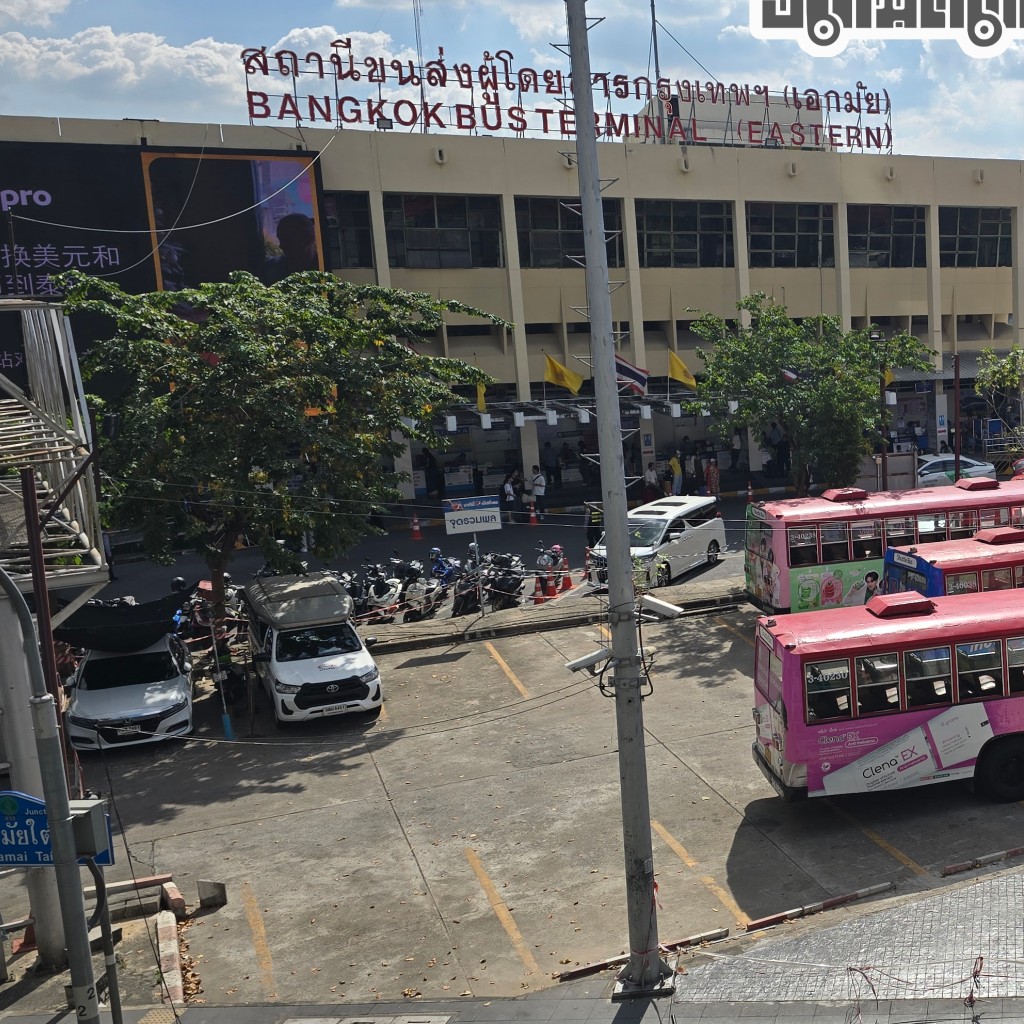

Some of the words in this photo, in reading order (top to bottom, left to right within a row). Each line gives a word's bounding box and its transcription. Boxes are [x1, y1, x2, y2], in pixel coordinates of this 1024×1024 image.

[241, 37, 771, 116] สถานีขนส่งผู้โดยารกรุงเทพฯ
[784, 80, 891, 116] (เอกมัย)
[246, 90, 448, 130] BANGKOK
[455, 100, 529, 134] BUS
[736, 117, 894, 150] (EASTERN)
[0, 188, 52, 212] pro
[1, 244, 121, 268] 换美元和
[5, 273, 76, 296] 到泰
[449, 514, 497, 529] จุดรวมพล
[862, 757, 898, 779] Clena
[900, 745, 919, 762] EX
[25, 808, 47, 816] Junct
[35, 851, 54, 862] Tai
